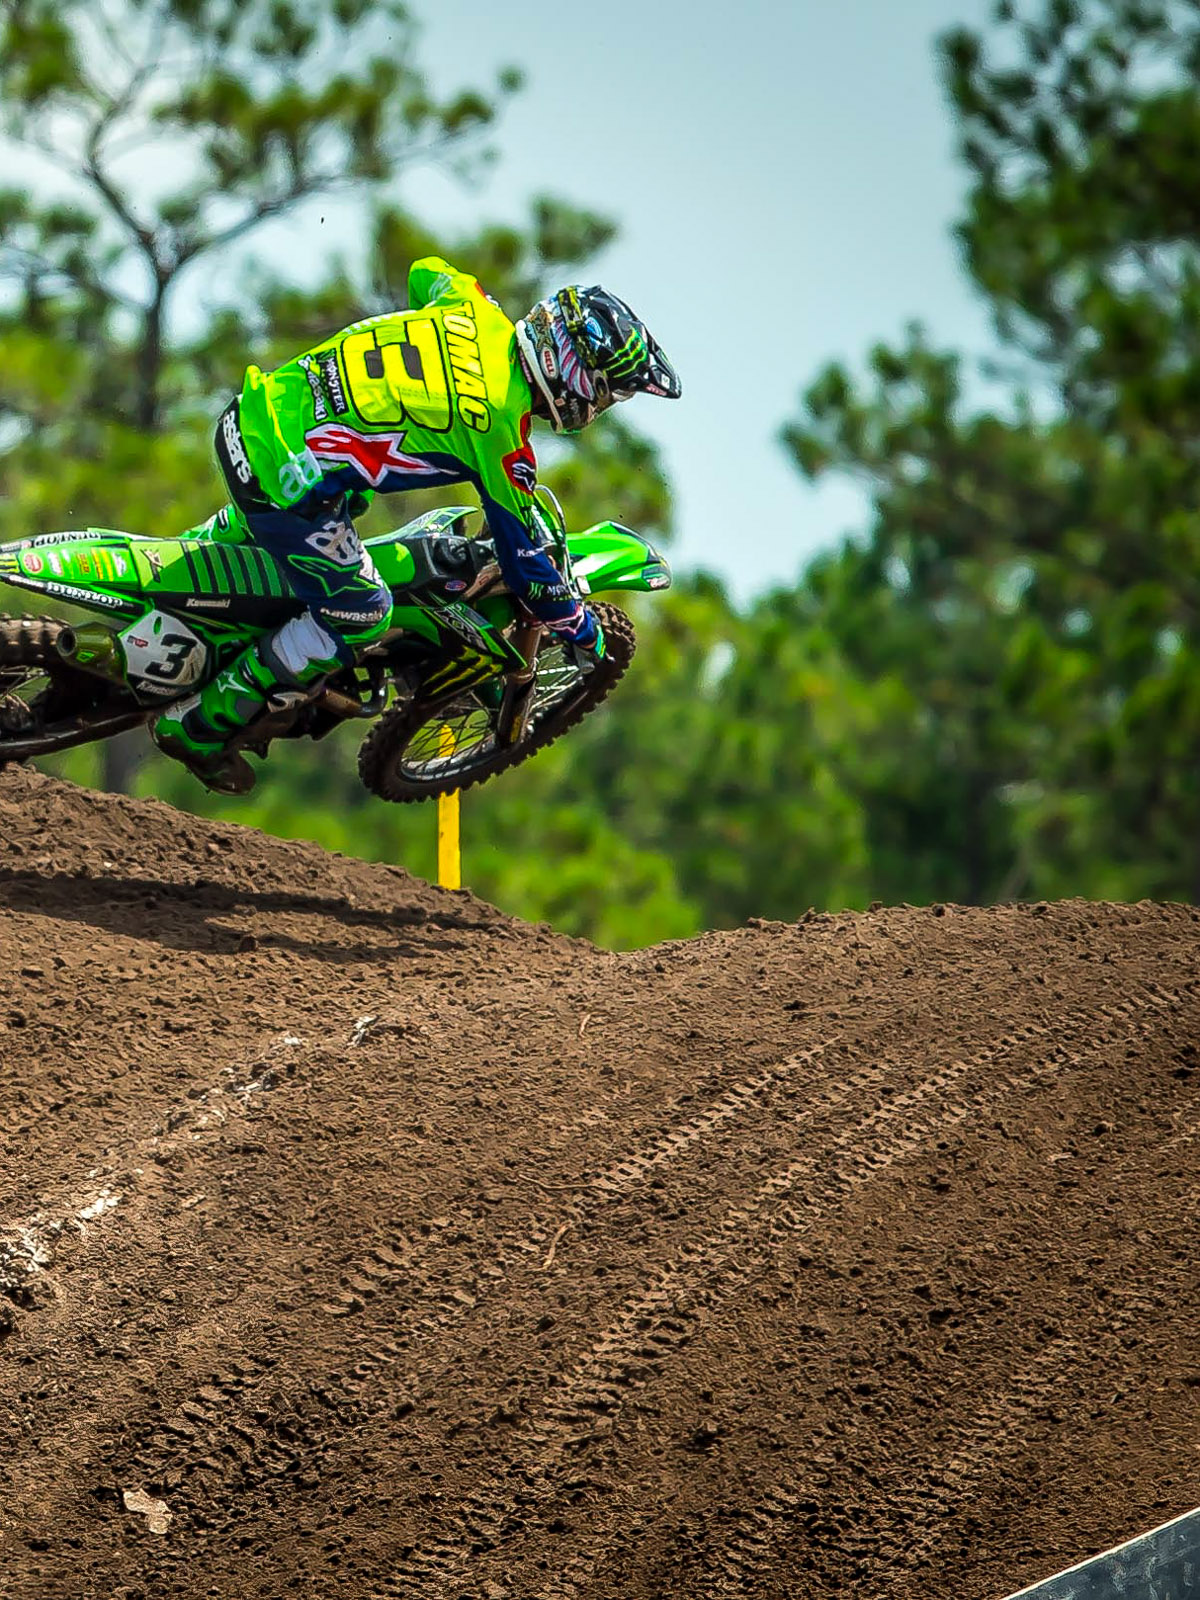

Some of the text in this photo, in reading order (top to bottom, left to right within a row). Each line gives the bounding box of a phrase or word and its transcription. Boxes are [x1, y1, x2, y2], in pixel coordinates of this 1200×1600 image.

[326, 358, 345, 412] MONSTER
[341, 318, 454, 433] 3
[441, 301, 491, 433] TOMAC
[543, 350, 555, 375] BELL
[145, 633, 198, 679] 3
